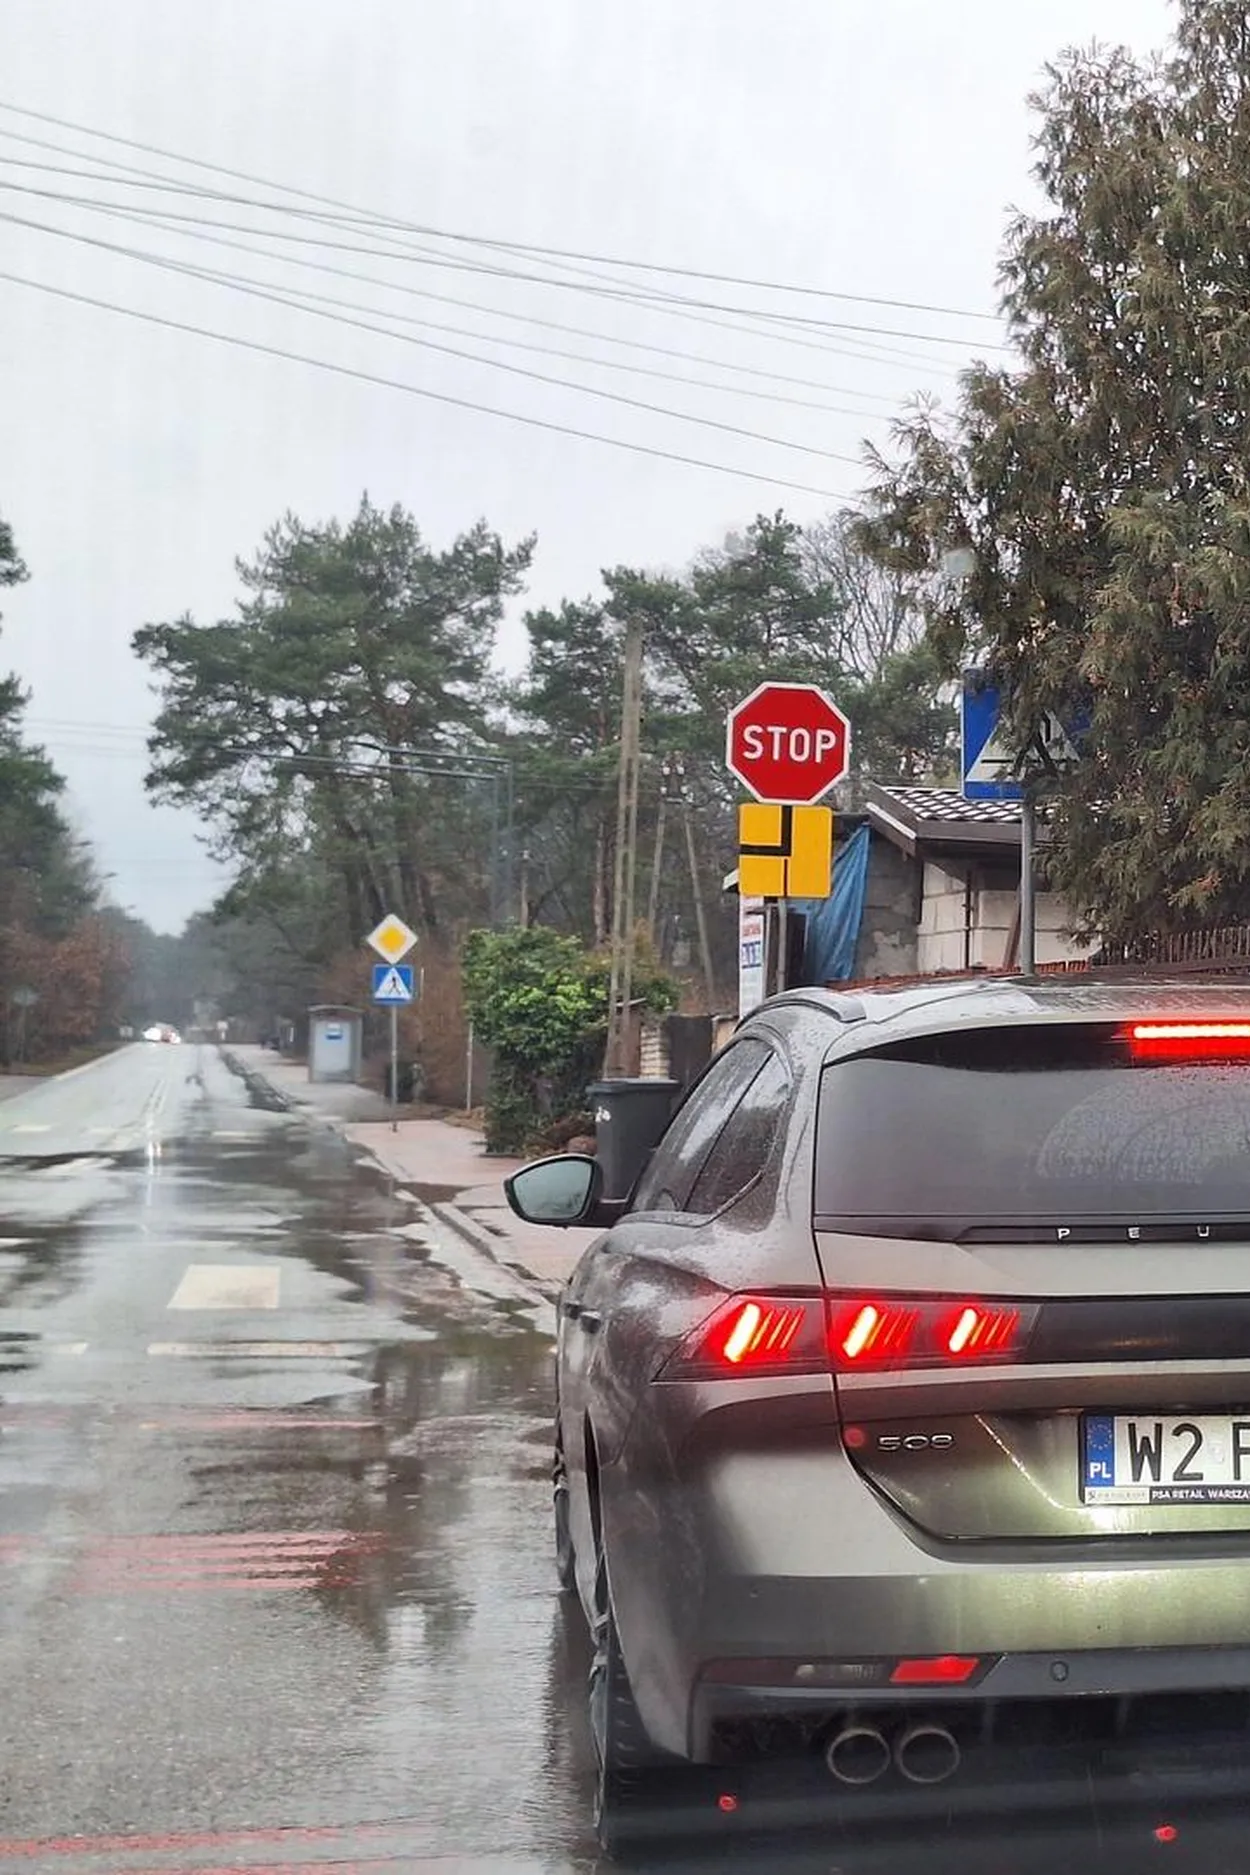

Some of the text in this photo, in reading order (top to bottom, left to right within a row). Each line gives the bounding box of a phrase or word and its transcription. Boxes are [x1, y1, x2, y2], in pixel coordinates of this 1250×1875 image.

[743, 724, 836, 763] STOP
[878, 1434, 954, 1450] 508
[1127, 1422, 1204, 1482] W2
[1089, 1461, 1111, 1479] PL
